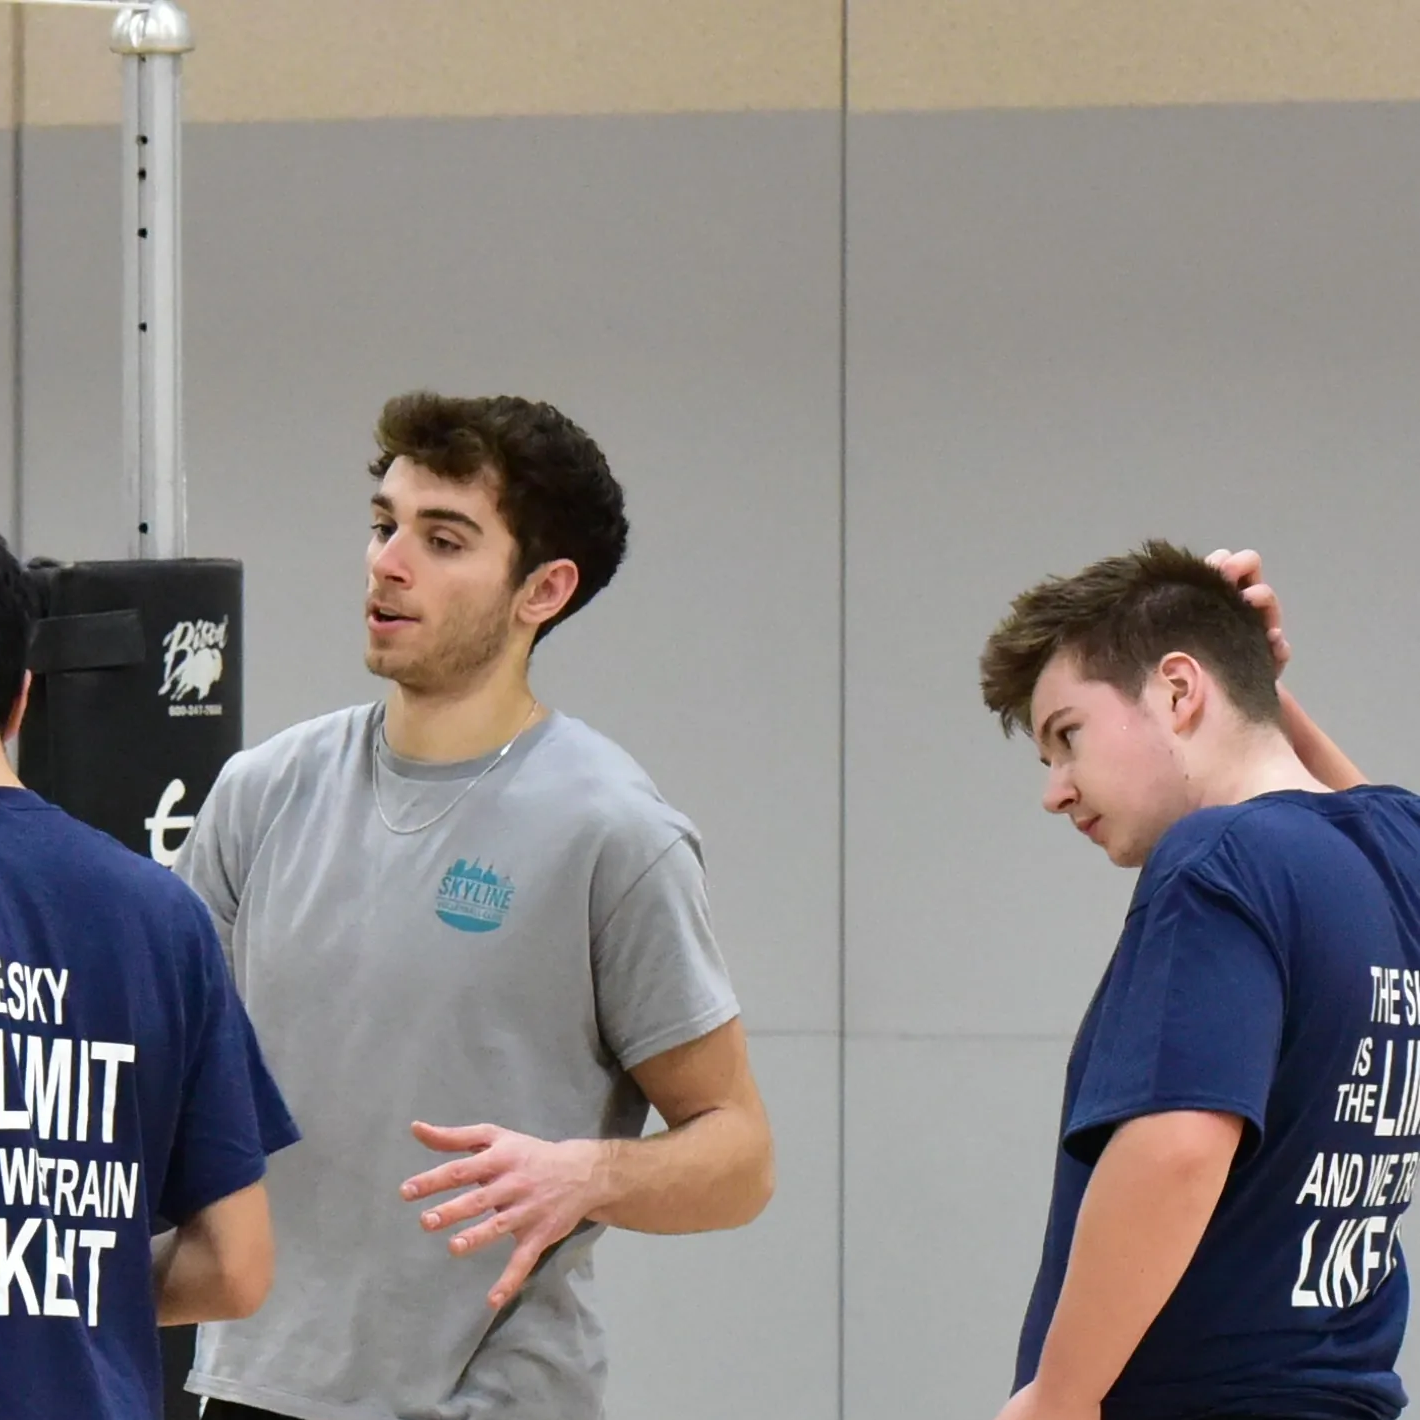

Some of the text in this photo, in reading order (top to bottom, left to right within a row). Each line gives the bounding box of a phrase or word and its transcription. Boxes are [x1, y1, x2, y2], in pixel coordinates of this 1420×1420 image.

[439, 875, 515, 910] SKYLINE
[7, 962, 69, 1025] SKY
[1370, 965, 1401, 1025] THE
[1352, 1036, 1373, 1077] IS
[1334, 1084, 1377, 1124] THE
[37, 1157, 139, 1219] TRAIN
[1295, 1152, 1364, 1208] AND
[1362, 1153, 1400, 1208] WE
